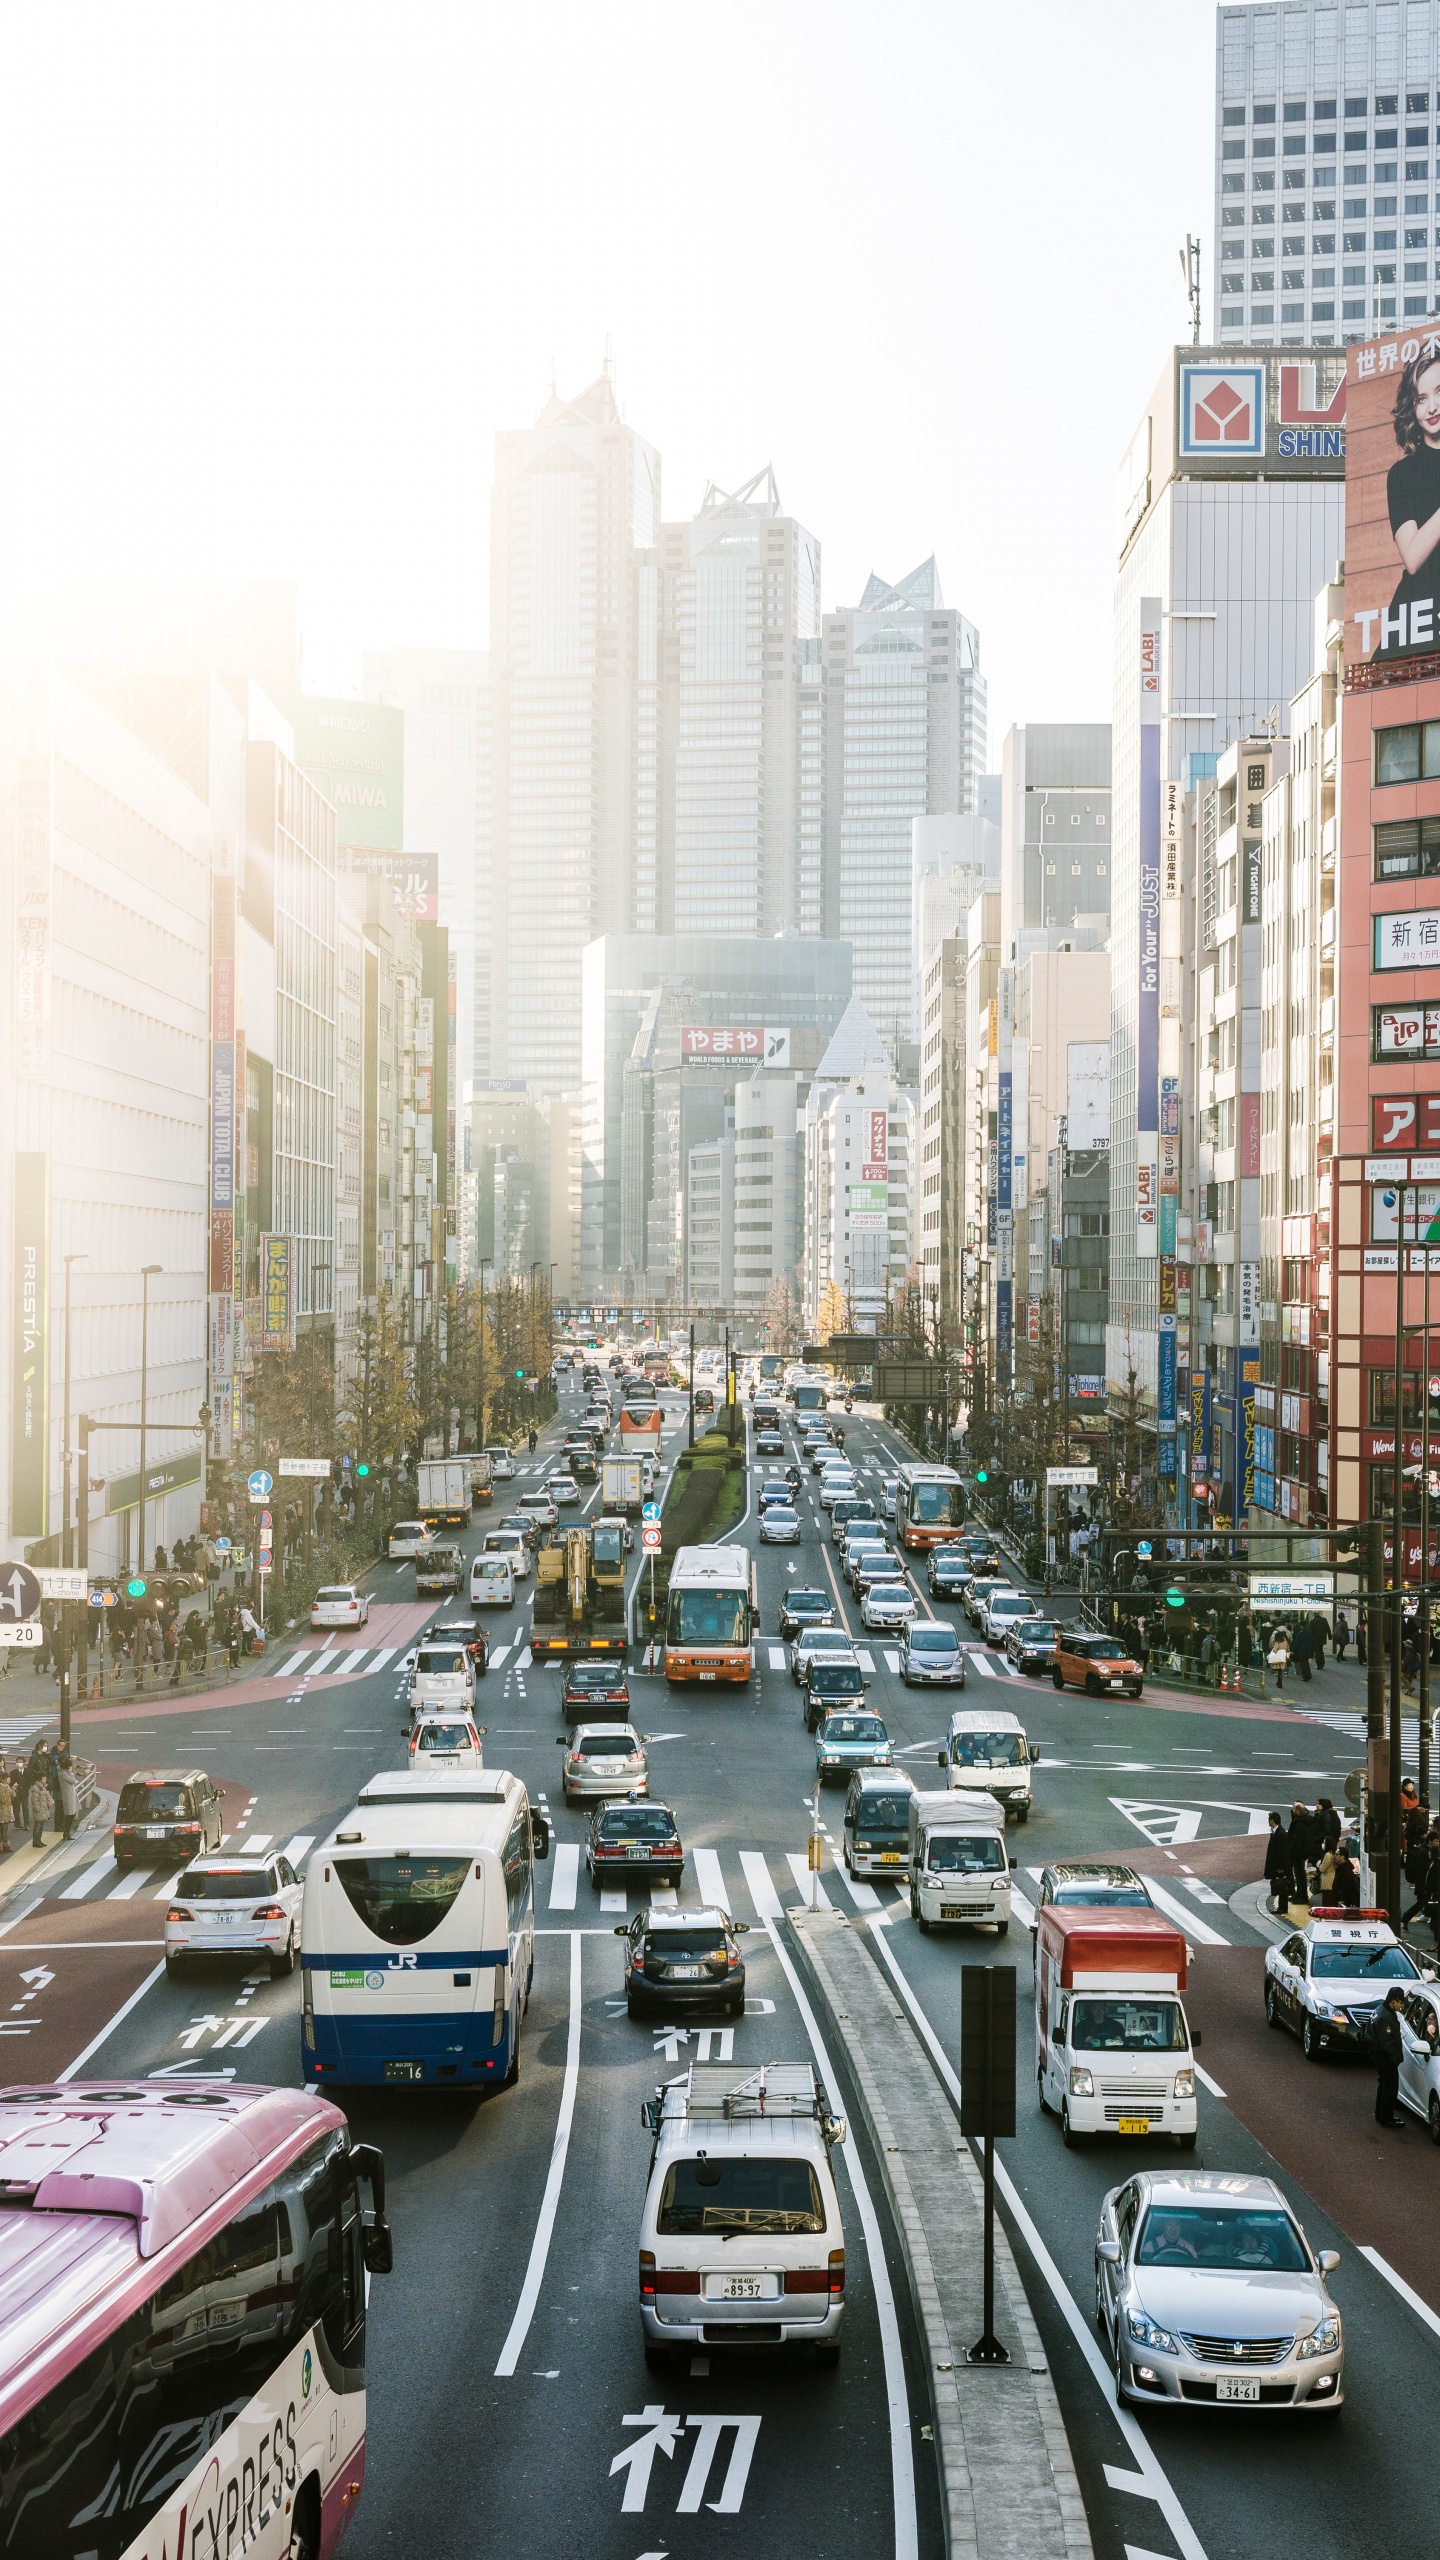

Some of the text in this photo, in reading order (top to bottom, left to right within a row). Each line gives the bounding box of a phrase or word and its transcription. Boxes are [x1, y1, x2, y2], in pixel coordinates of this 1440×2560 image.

[1354, 598, 1433, 653] THE
[1142, 633, 1154, 672] LABI
[329, 753, 349, 767] Next
[350, 756, 386, 773] Security
[334, 785, 387, 808] MIWA
[1168, 785, 1176, 836] ラミネートの
[36, 828, 47, 852] 品川
[1250, 866, 1259, 917] TIGHT ONE
[18, 917, 48, 930] KEN
[1141, 864, 1159, 992] For Your JUST
[1391, 918, 1440, 948] 新宿
[21, 930, 30, 966] スクール
[35, 930, 45, 966] パソコン
[1402, 949, 1440, 962] 月々1万円
[21, 971, 31, 1019] クリニック
[218, 960, 230, 1031] 品川美容外科
[955, 953, 967, 1071] ホウライビル
[218, 1031, 230, 1040] 6F
[688, 1030, 758, 1052] やまや
[1425, 1024, 1440, 1045] エ
[731, 1056, 758, 1064] BEVERAGE
[1162, 1078, 1178, 1092] 6F
[215, 1069, 231, 1201] JAPAN TOTAL CLUB
[873, 1116, 885, 1157] クリナップ
[999, 1086, 1011, 1188] アートネイチャー
[1092, 1138, 1110, 1148] 3797
[1250, 1109, 1258, 1166] ワールドメイト
[1138, 1165, 1150, 1205] LABI
[999, 1215, 1011, 1223] 6F
[222, 1219, 232, 1291] パソコンスクール
[1162, 1256, 1175, 1264] 3F
[1365, 1256, 1405, 1265] お部屋探し
[268, 1241, 287, 1331] まんが喫茶
[1162, 1266, 1175, 1305] トレカ
[1242, 1264, 1252, 1321] 本気の発毛治療
[1029, 1307, 1039, 1340] お弁当
[1192, 1373, 1205, 1386] 薬
[1192, 1388, 1204, 1454] マツモトキヨシ
[1372, 1439, 1405, 1455] Wends
[40, 1577, 82, 1590] 1丁目
[1258, 1583, 1326, 1594] 西新宿一丁目
[92, 1595, 103, 1604] 414
[1254, 1597, 1297, 1606] Nishishinjuku
[1331, 1929, 1379, 1938] 警視庁
[388, 1953, 417, 1970] JR
[1272, 1981, 1291, 2009] POLICE
[653, 2026, 735, 2062] 初
[409, 2066, 422, 2079] 16
[730, 2284, 761, 2296] 89-97
[1226, 2386, 1256, 2399] 34-61
[608, 2405, 762, 2513] 初
[191, 2401, 297, 2560] EXPRESS
